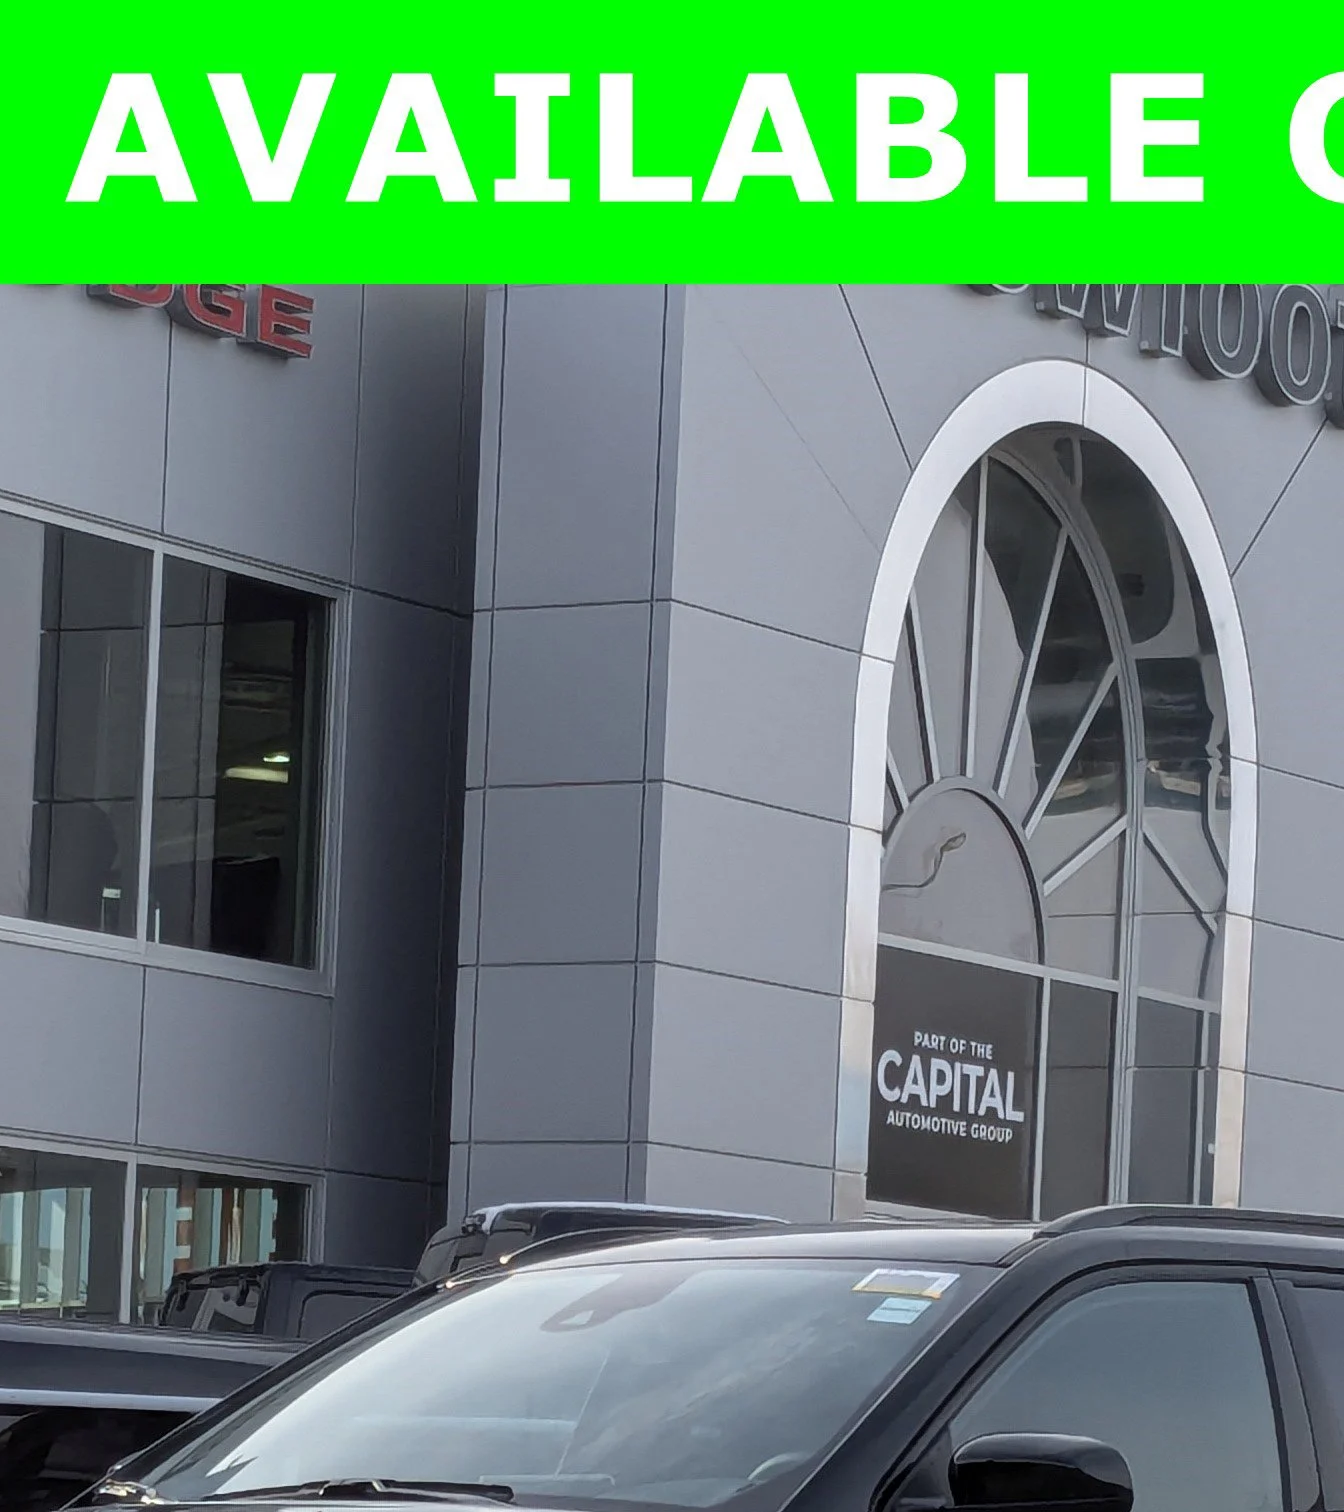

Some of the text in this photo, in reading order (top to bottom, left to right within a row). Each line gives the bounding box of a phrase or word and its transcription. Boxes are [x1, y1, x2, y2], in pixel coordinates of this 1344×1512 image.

[914, 1031, 993, 1060] PART OF THE
[877, 1050, 1025, 1123] CAPITAL
[886, 1110, 1013, 1144] AUTOMOTIVE GROUP
